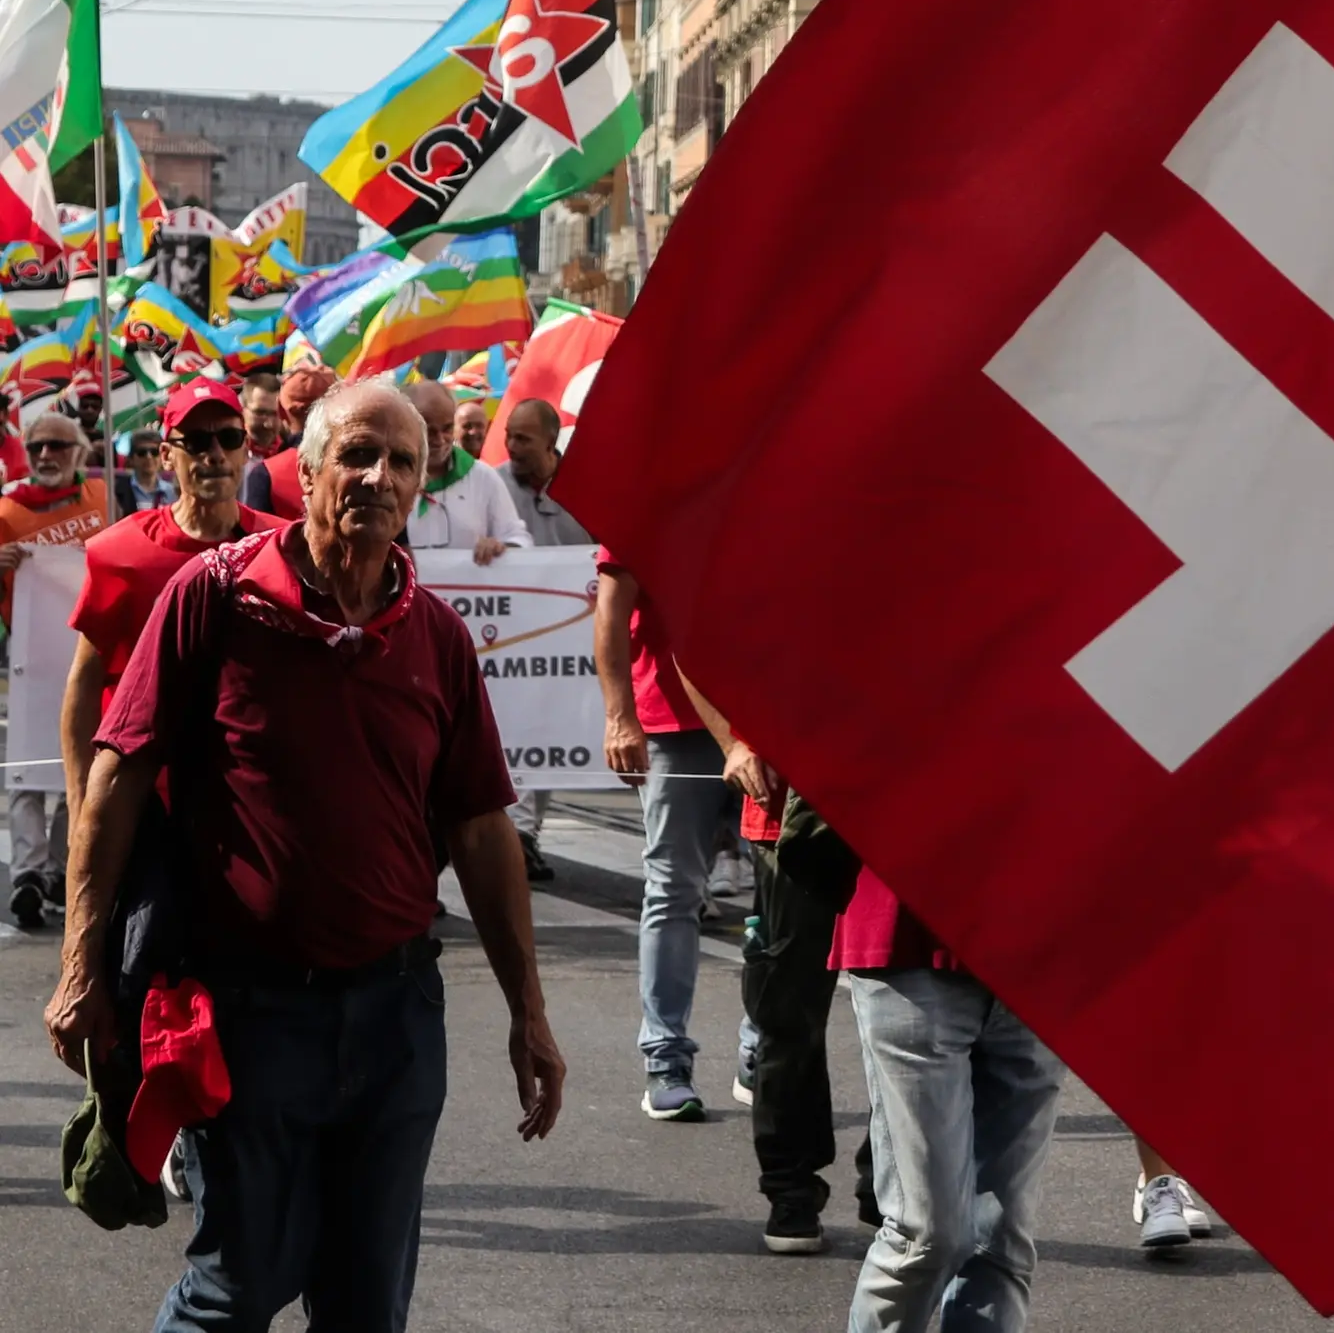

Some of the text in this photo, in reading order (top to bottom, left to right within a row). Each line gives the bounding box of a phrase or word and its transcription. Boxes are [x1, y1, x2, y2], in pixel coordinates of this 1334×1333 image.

[446, 596, 511, 617] ONE
[481, 655, 600, 678] AMBIEN
[502, 745, 591, 768] VORO
